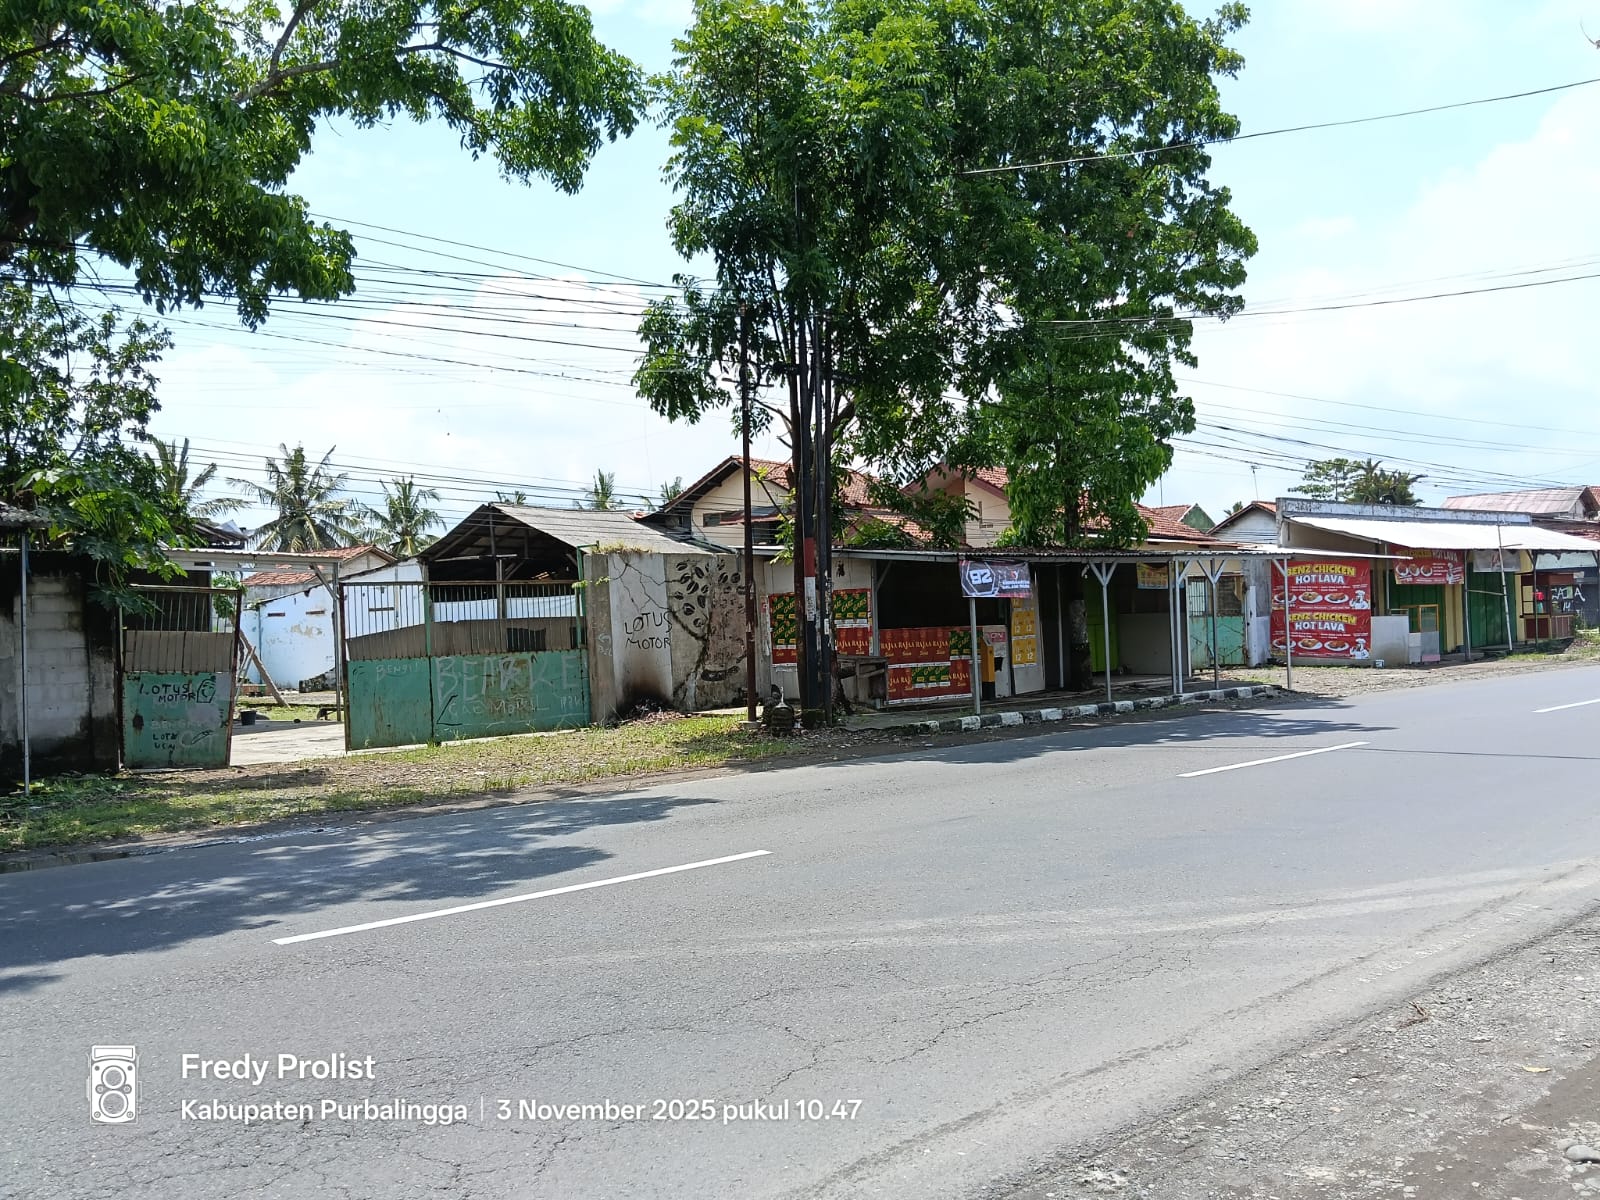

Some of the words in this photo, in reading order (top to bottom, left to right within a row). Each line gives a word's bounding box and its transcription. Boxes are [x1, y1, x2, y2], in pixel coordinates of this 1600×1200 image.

[1313, 564, 1356, 577] CHICKEN
[1295, 574, 1318, 584] HOT
[1319, 574, 1345, 584] LAVA
[624, 610, 673, 635] LOTUS
[1313, 611, 1357, 625] CHICKEN
[1295, 621, 1318, 631] HOT
[1319, 621, 1345, 632] LAVA
[625, 637, 671, 649] MOTOR
[139, 683, 190, 695] LOTUS
[158, 692, 196, 702] MOTOR
